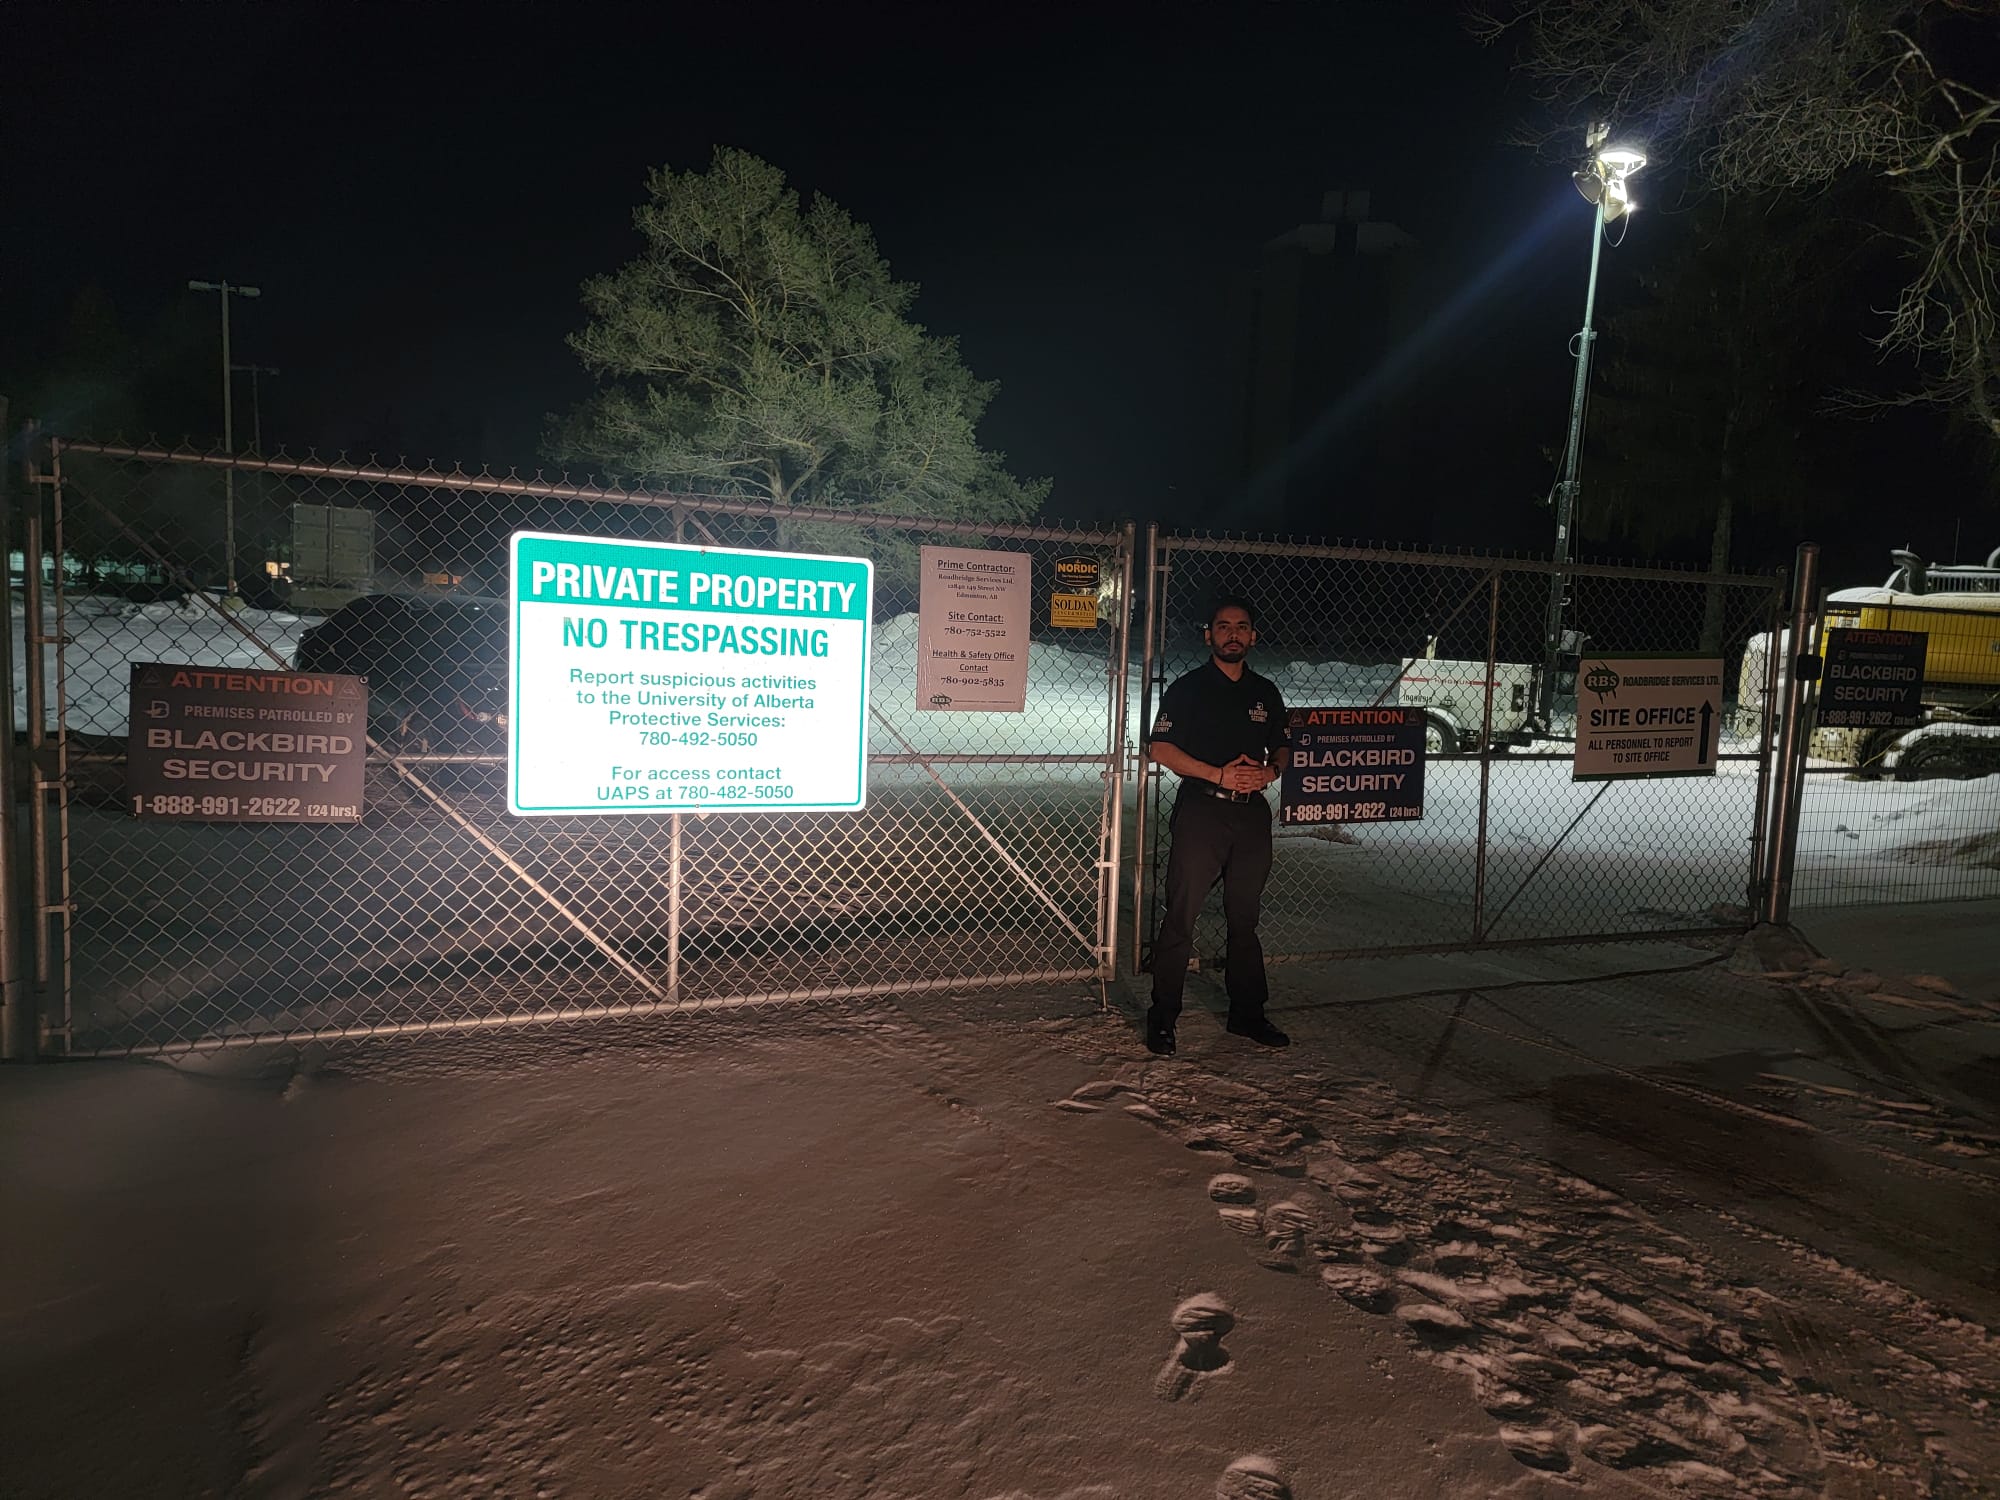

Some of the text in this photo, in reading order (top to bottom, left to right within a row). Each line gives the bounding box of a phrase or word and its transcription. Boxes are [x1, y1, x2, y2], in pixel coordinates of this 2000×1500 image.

[937, 559, 1016, 574] Prime Contractor:
[1057, 563, 1098, 574] NORDIC
[532, 561, 857, 613] PRIVATE PROPERTY
[976, 575, 1001, 584] Services
[1054, 599, 1095, 611] SOLDAN
[948, 611, 1004, 623] Site Contact:
[563, 617, 829, 657] NO TRESPASSING
[944, 626, 1006, 638] 780-752-5522
[1844, 631, 1914, 646] ATTENTION
[932, 649, 1015, 660] Health & Safety Office
[959, 663, 989, 672] Contact
[1830, 664, 1917, 681] BLACKBIRD
[171, 671, 334, 696] ATTENTION
[570, 668, 817, 690] Report suspicious activities
[940, 675, 1005, 687] 780-902-5835
[1586, 675, 1618, 687] RBS
[1622, 675, 1720, 687] ROADBRIDGE SERVICES LTD.
[576, 690, 814, 711] to the University of Alberta
[1834, 686, 1909, 702] SECURITY
[184, 705, 354, 724] PREMISES PATROLLED BY
[609, 711, 786, 728] Protective Services:
[1307, 710, 1405, 725] ATTENTION
[1590, 707, 1696, 727] SITE OFFICE
[1820, 710, 1893, 725] 1-888-991-2622
[147, 728, 353, 755] BLACKBIRD
[639, 731, 758, 746] 780-492-5050
[1317, 735, 1350, 744] PREMISES
[1350, 735, 1386, 743] PATROLLED
[1588, 737, 1694, 751] ALL PERSONNEL TO REPORT
[1293, 749, 1415, 768] BLACKBIRD
[1613, 751, 1670, 763] TO SITE OFFICE
[162, 759, 338, 783] SECURITY
[612, 766, 781, 781] For access contact
[1302, 774, 1406, 793] SECURITY
[597, 785, 794, 801] UAPS at 780-482-5050
[133, 795, 357, 818] 1-888-991-2622 (24 hrs)
[1284, 802, 1420, 822] 1-888-991-2622 (24 hrs)
